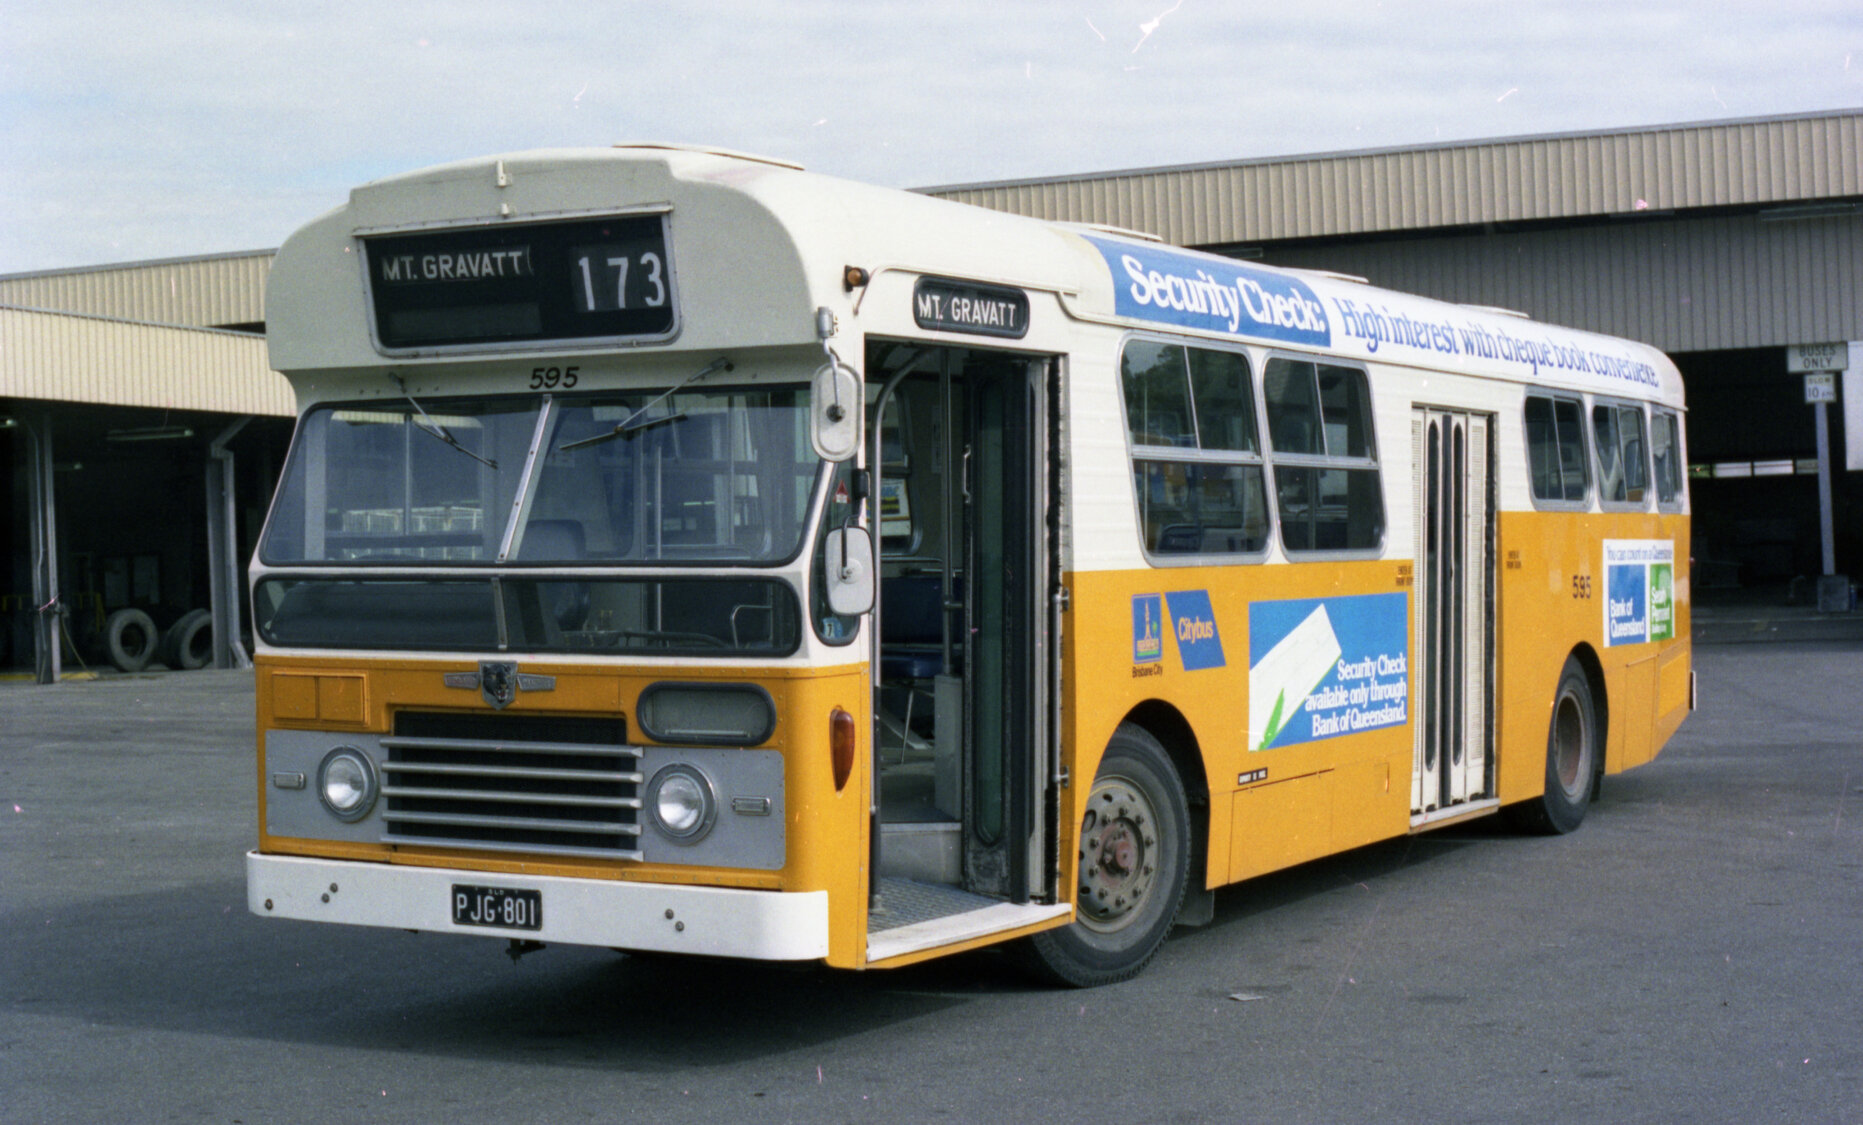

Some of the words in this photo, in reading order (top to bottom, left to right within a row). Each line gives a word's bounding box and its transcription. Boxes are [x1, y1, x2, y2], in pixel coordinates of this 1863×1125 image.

[382, 255, 418, 280] MT.
[422, 250, 523, 280] GRAVATT
[578, 252, 666, 311] 173
[1121, 254, 1240, 333] Security
[1236, 276, 1327, 333] Check:
[917, 293, 944, 320] MT.
[951, 296, 1016, 327] GRAVATT
[1332, 297, 1390, 353] High
[1382, 305, 1460, 354] interest
[1459, 321, 1499, 360] with
[1497, 327, 1555, 376] cheque
[1546, 336, 1591, 373] book
[528, 366, 580, 389] 595
[1803, 357, 1832, 369] ONLY
[1808, 387, 1820, 398] 10
[1572, 575, 1591, 599] 595
[1610, 598, 1627, 618] Bank
[1626, 598, 1634, 616] of
[1178, 616, 1214, 644] Citybus
[1610, 617, 1645, 638] Queensland
[1153, 663, 1163, 677] City
[1337, 655, 1377, 682] Security
[1377, 651, 1407, 676] Check
[1304, 684, 1349, 712] available
[1349, 681, 1370, 709] only
[1370, 676, 1407, 704] through
[1312, 711, 1340, 737] Bank
[1339, 708, 1351, 731] of
[1350, 700, 1407, 730] Queensland.
